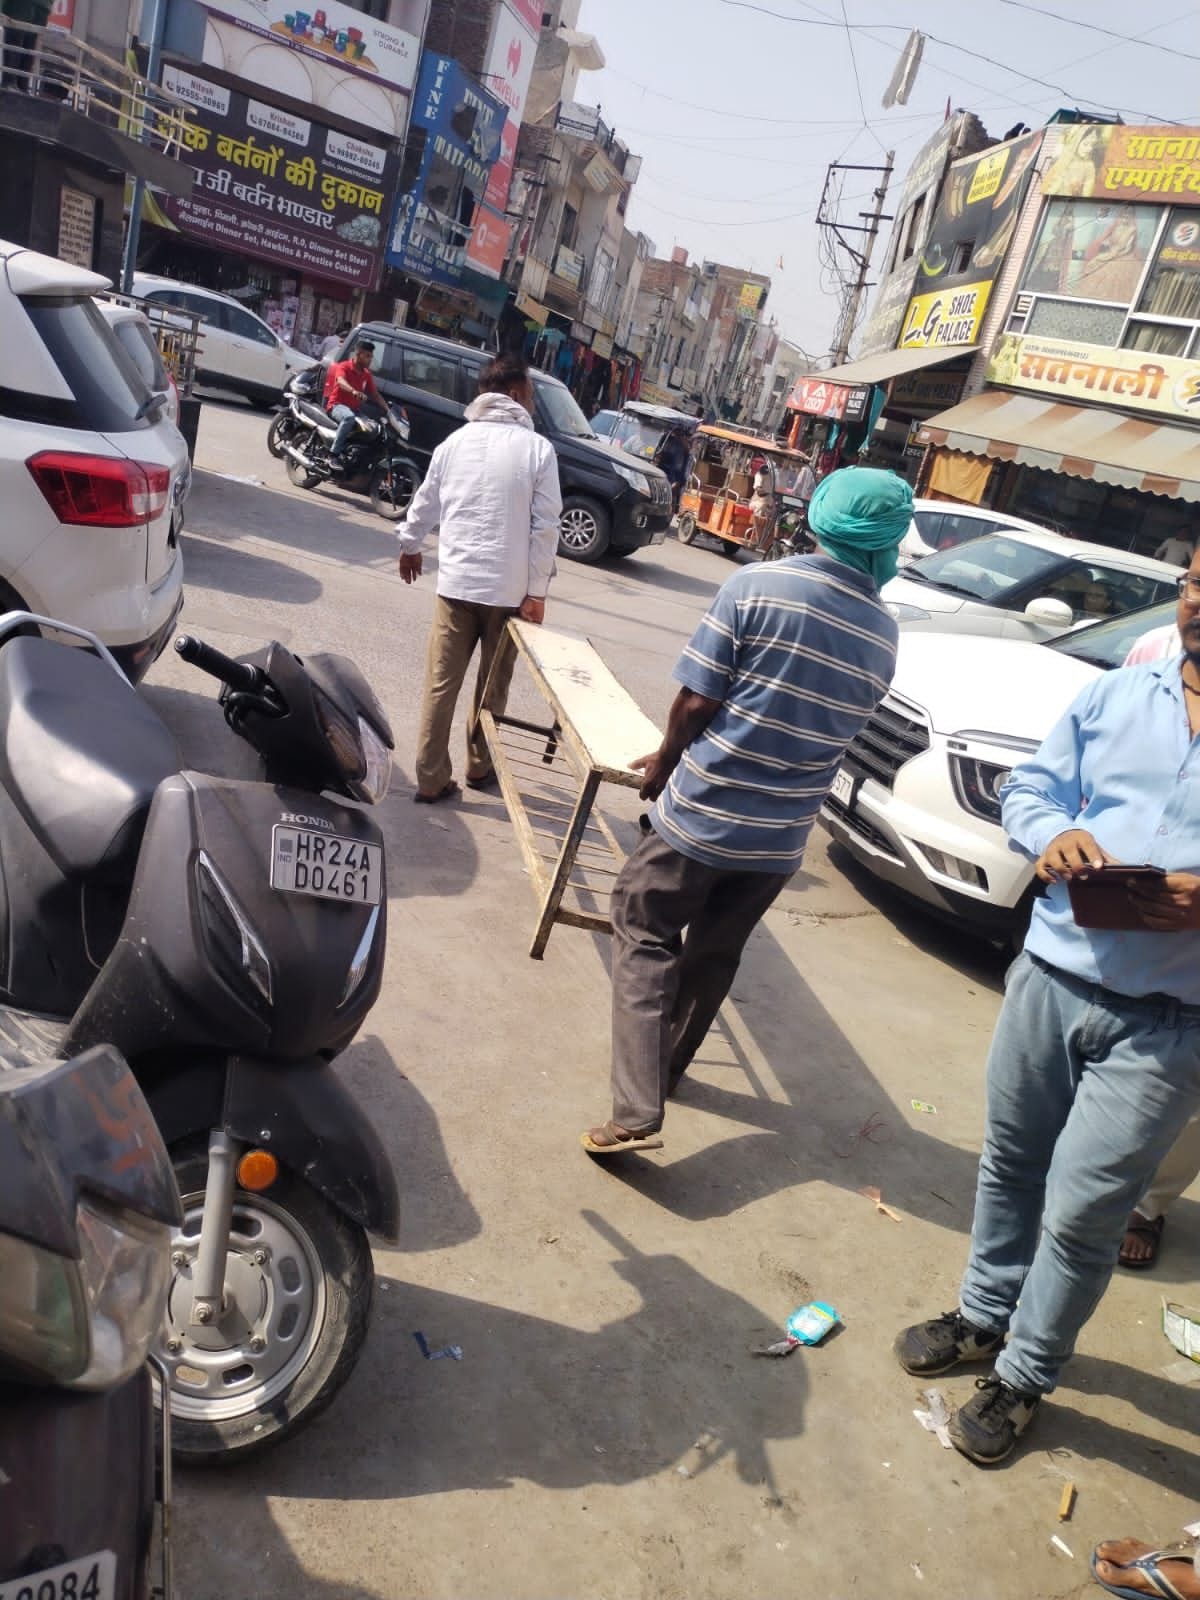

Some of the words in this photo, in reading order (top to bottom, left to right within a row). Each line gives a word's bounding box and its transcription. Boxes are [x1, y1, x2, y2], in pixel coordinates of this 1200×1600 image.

[378, 40, 409, 58] DURABLE
[424, 59, 450, 120] FINE
[216, 135, 285, 178] बर्तनों
[285, 156, 318, 192] की
[321, 173, 385, 216] दुकान
[206, 169, 233, 197] जी
[233, 178, 276, 212] बर्तन
[276, 195, 337, 232] भण्डार
[949, 292, 977, 316] SHOE
[936, 319, 974, 343] PALACE
[1020, 352, 1170, 400] सतनाली
[280, 812, 336, 832] HONDA
[296, 833, 370, 872] HR24A
[295, 862, 368, 900] D0461
